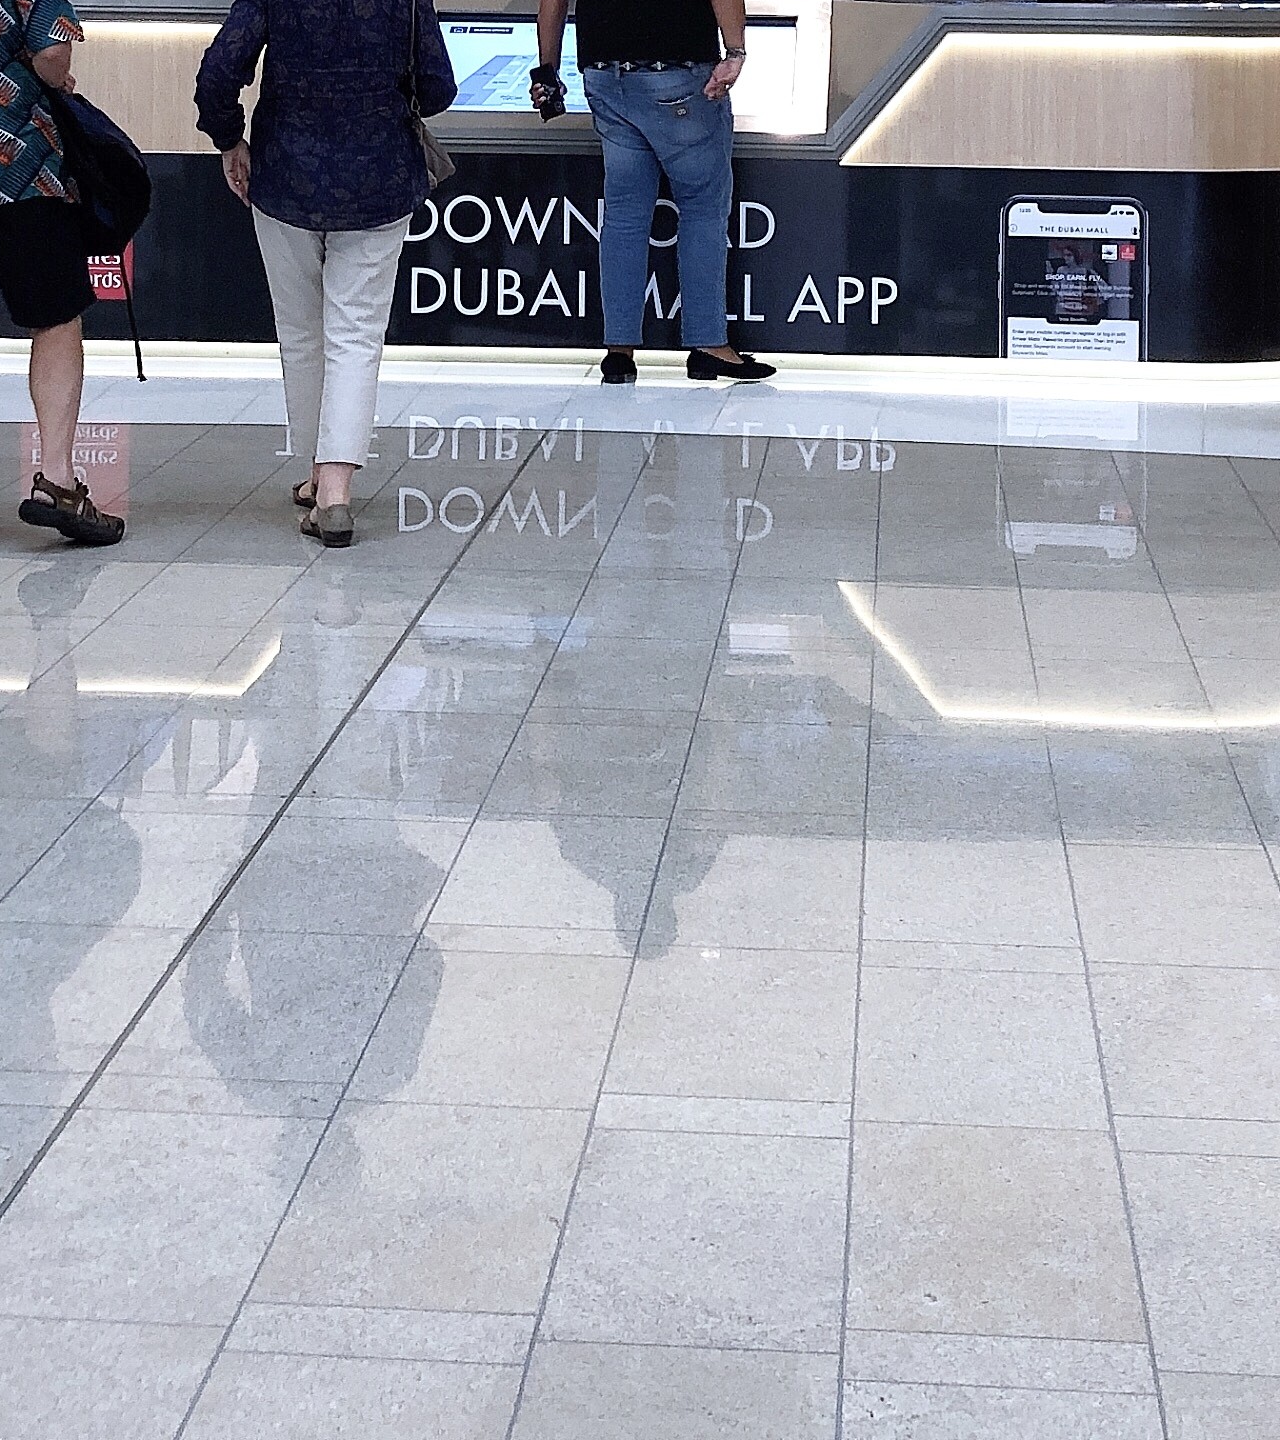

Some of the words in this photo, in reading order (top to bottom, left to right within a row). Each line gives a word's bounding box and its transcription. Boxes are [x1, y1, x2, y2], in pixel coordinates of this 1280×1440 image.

[403, 194, 776, 249] DOWNOD
[1039, 225, 1055, 233] THE
[1086, 226, 1109, 234] MALL
[90, 271, 122, 289] rds
[410, 267, 586, 318] DUBAI
[786, 273, 899, 325] APP
